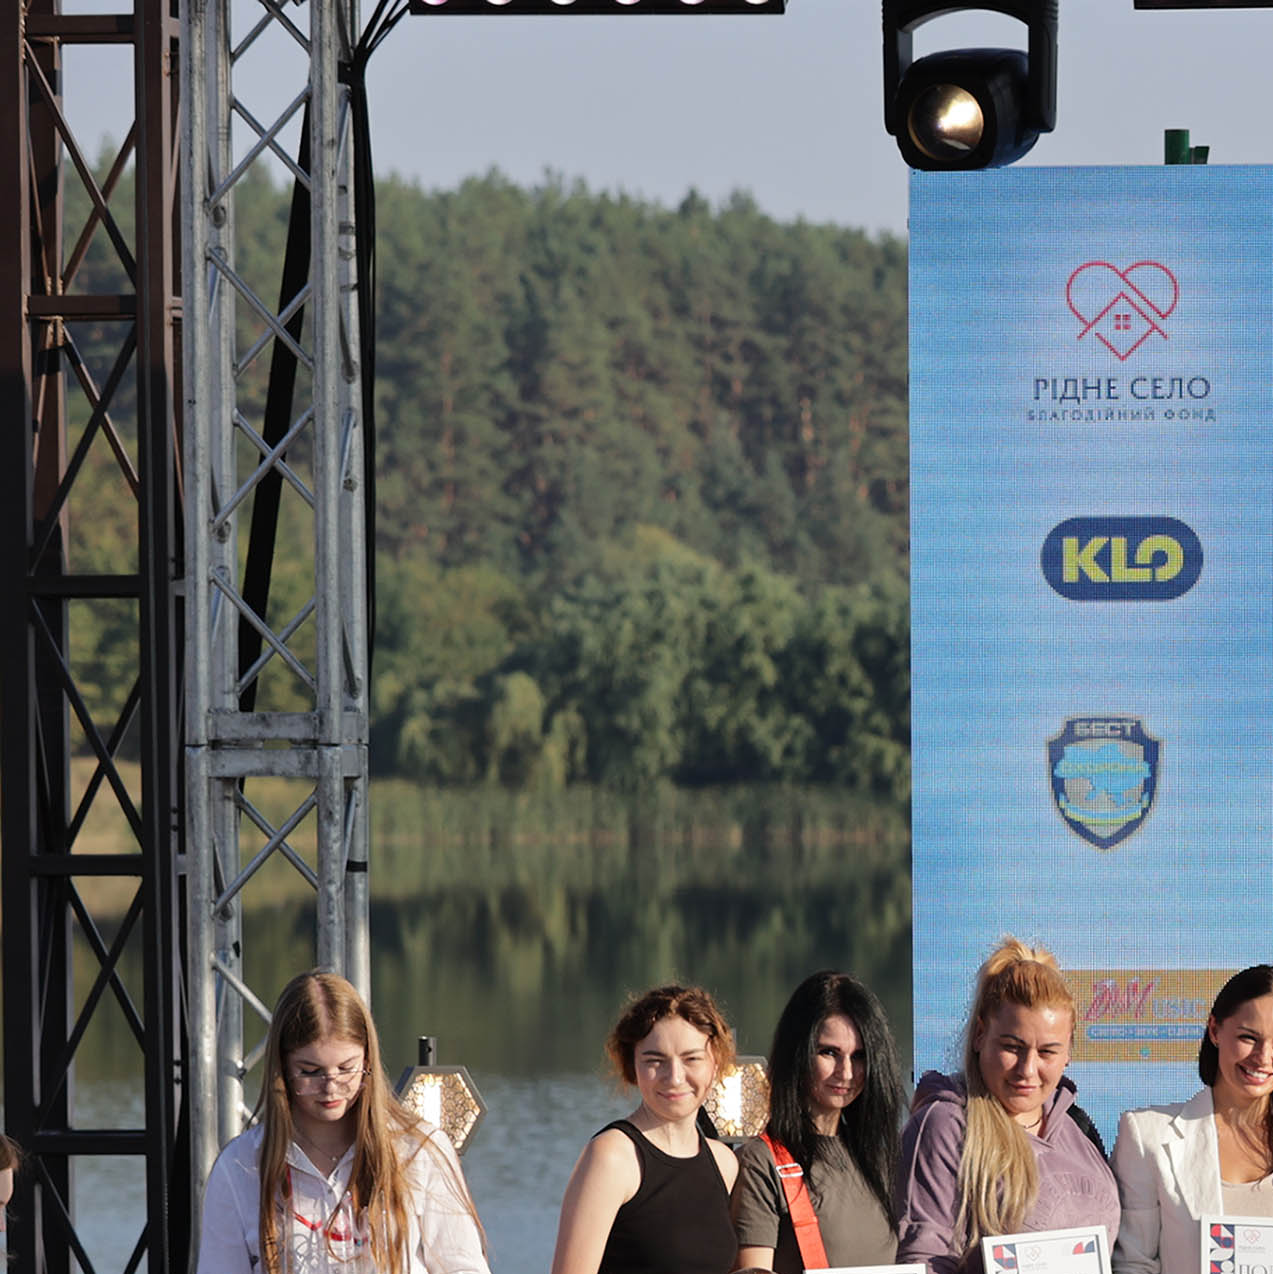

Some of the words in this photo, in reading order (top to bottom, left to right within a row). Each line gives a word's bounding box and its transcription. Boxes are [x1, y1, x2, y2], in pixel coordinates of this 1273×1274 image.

[1033, 376, 1120, 405] РІДНЕ
[1130, 376, 1211, 401] СЕЛО
[1028, 406, 1156, 424] БЛАГОДІЙНИЙ
[1164, 408, 1217, 423] ФОНД
[1062, 533, 1184, 583] KLO
